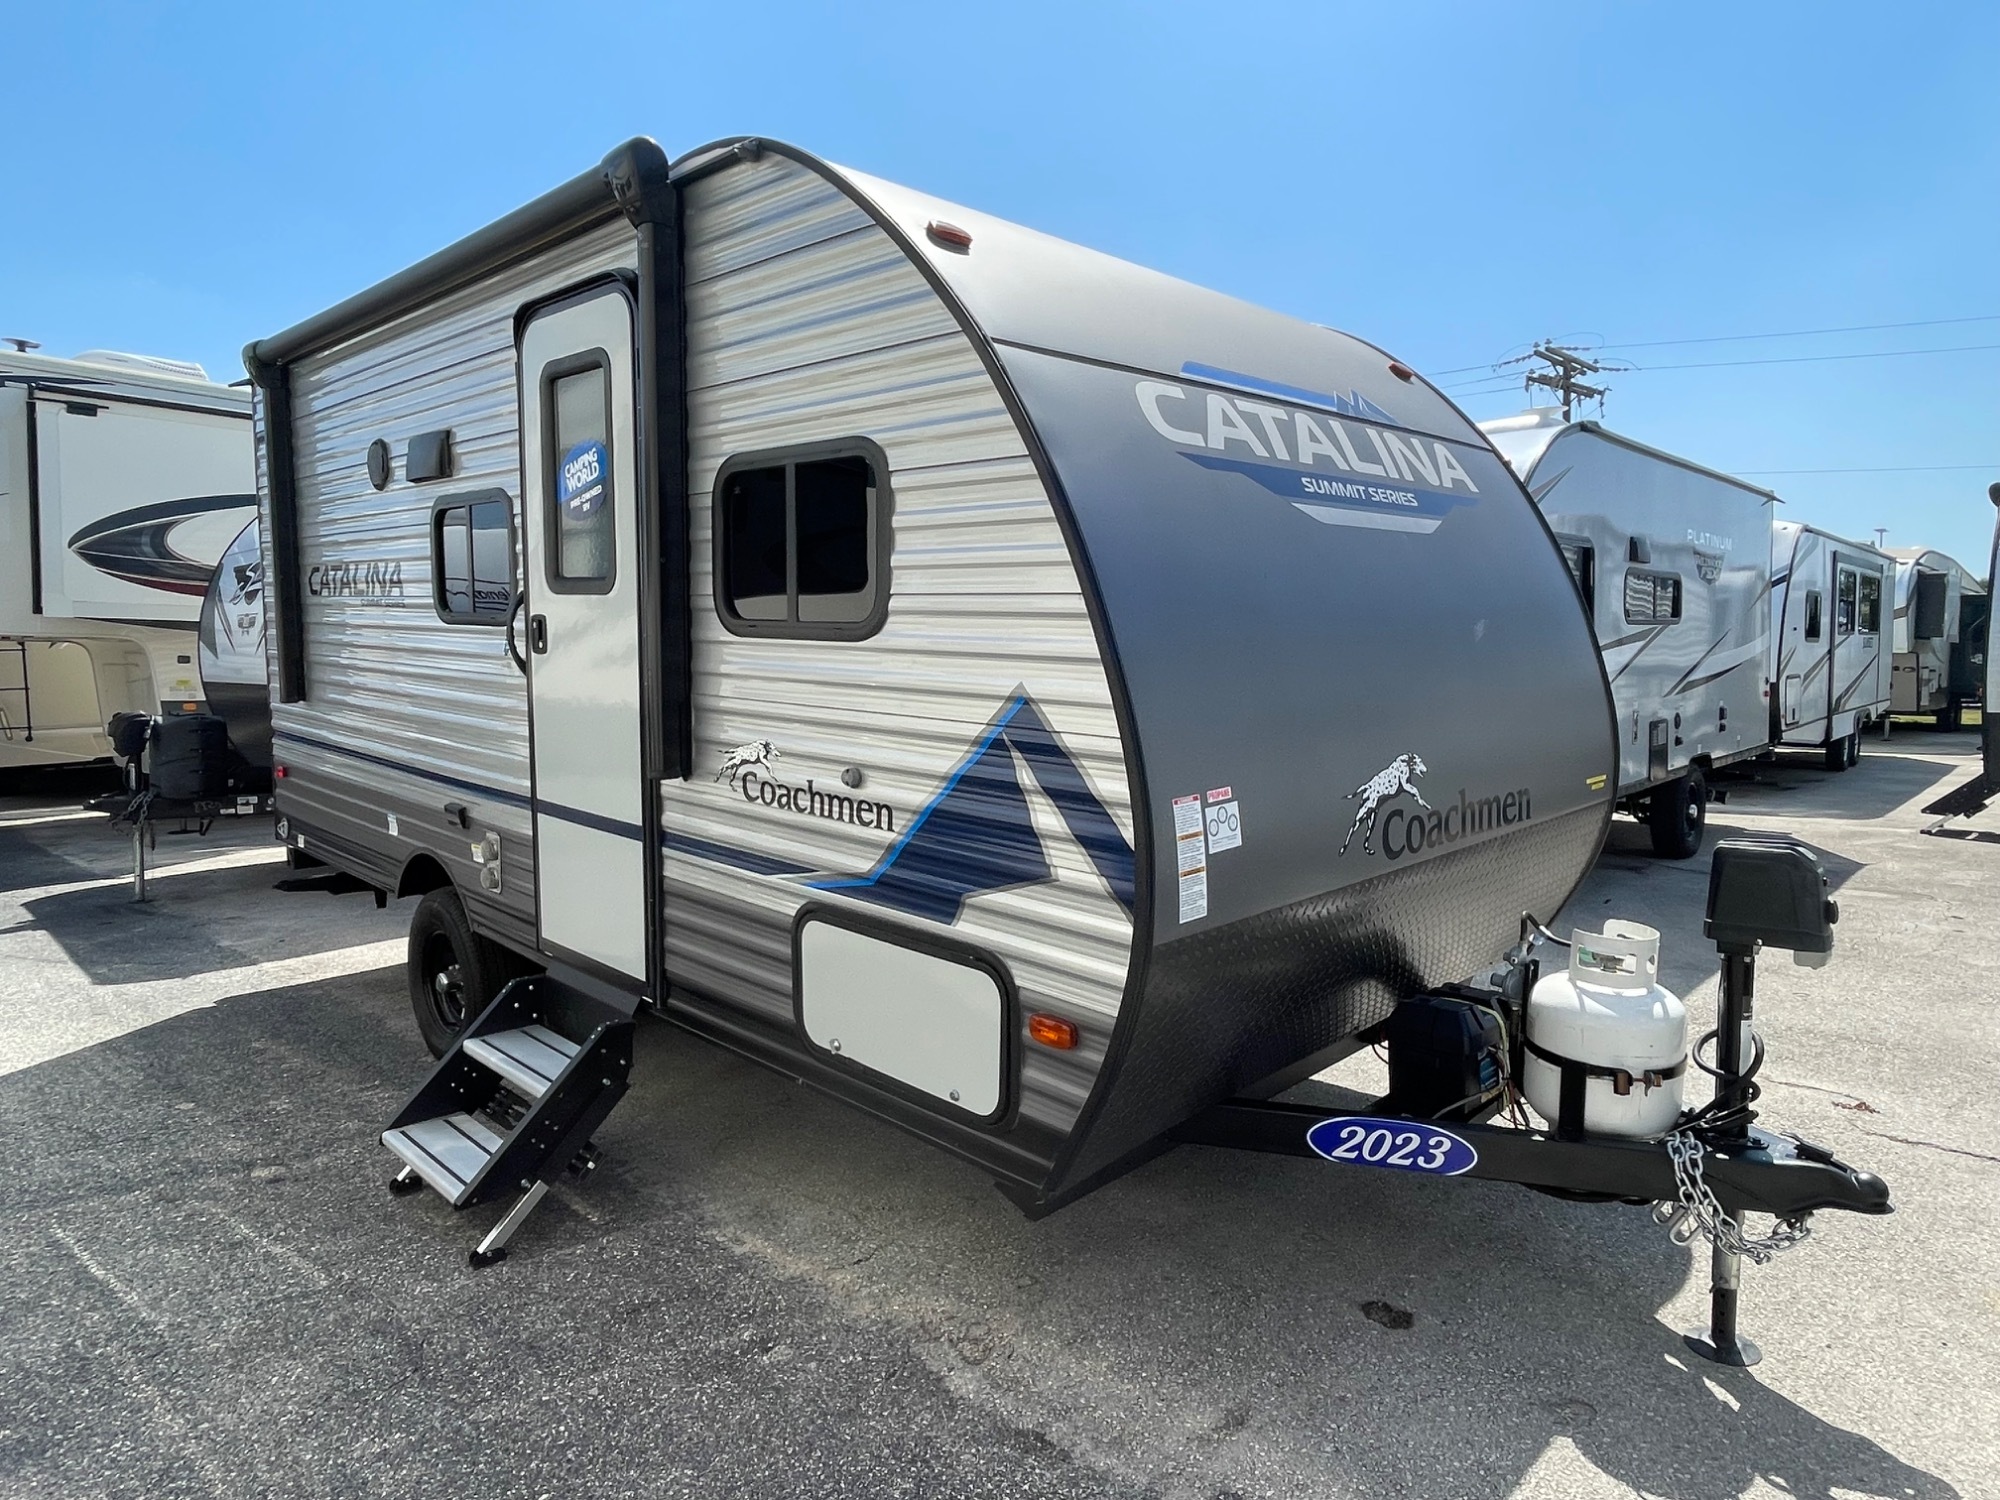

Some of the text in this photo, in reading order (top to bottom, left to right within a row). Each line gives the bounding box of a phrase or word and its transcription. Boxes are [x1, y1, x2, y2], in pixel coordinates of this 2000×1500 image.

[1135, 381, 1480, 493] CATALINA
[565, 447, 598, 477] CAMPING
[566, 462, 599, 492] WORLD
[1300, 476, 1419, 507] SUMMIT SERIES
[1687, 528, 1732, 551] PLATINUM
[308, 560, 404, 597] CATALINA
[742, 771, 896, 833] Coachmen
[1208, 788, 1230, 800] PROPANE
[1381, 786, 1532, 861] Coachmen
[1331, 1125, 1452, 1169] 2023
